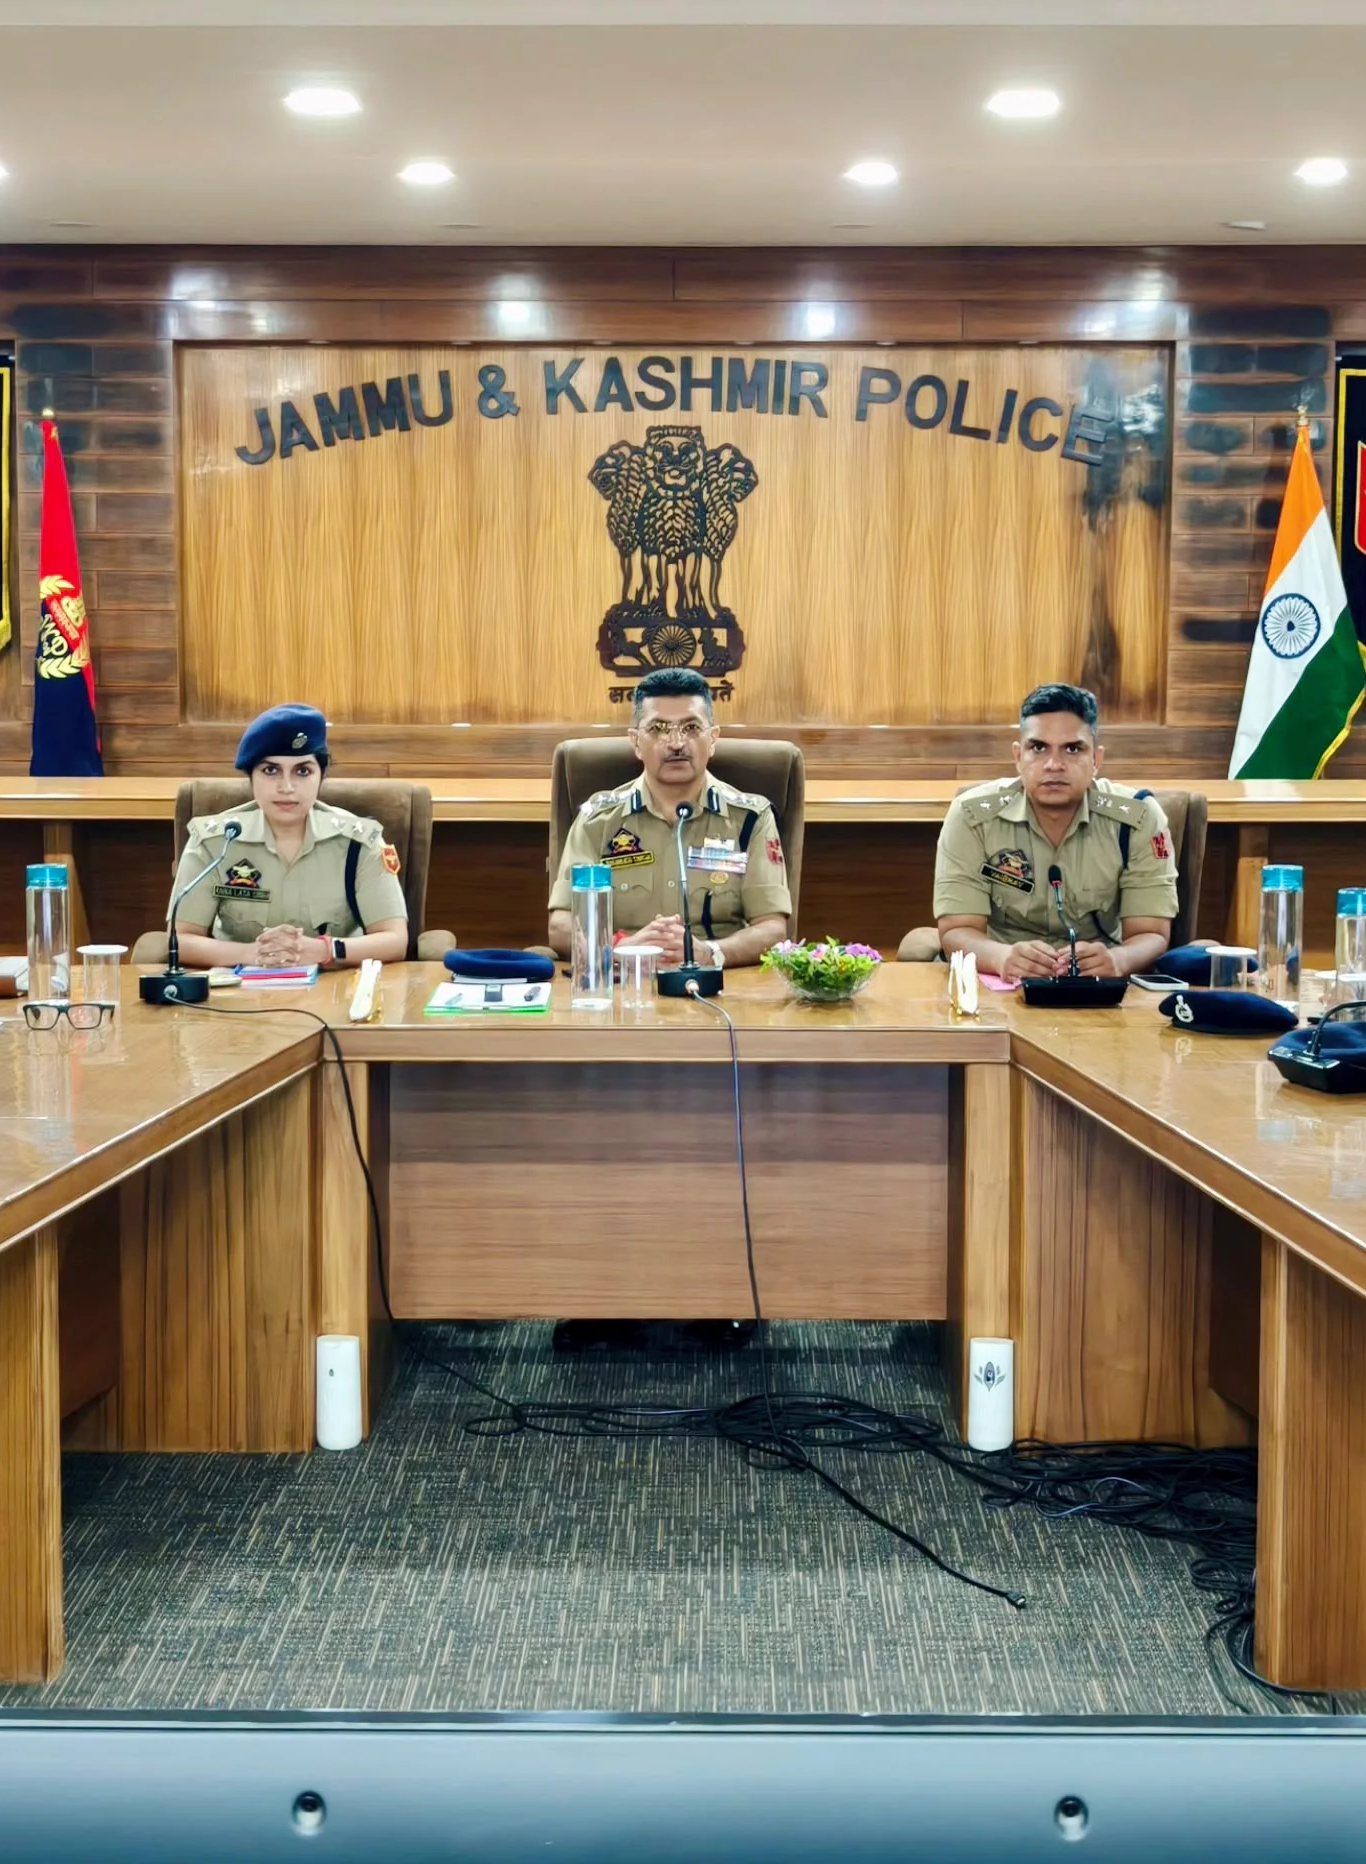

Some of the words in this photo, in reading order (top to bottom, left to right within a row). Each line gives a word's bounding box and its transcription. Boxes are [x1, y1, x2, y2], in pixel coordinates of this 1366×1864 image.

[236, 370, 454, 466] JAMMU
[476, 364, 520, 419] &
[544, 356, 829, 418] KASHMIR
[855, 367, 1117, 467] POLICE
